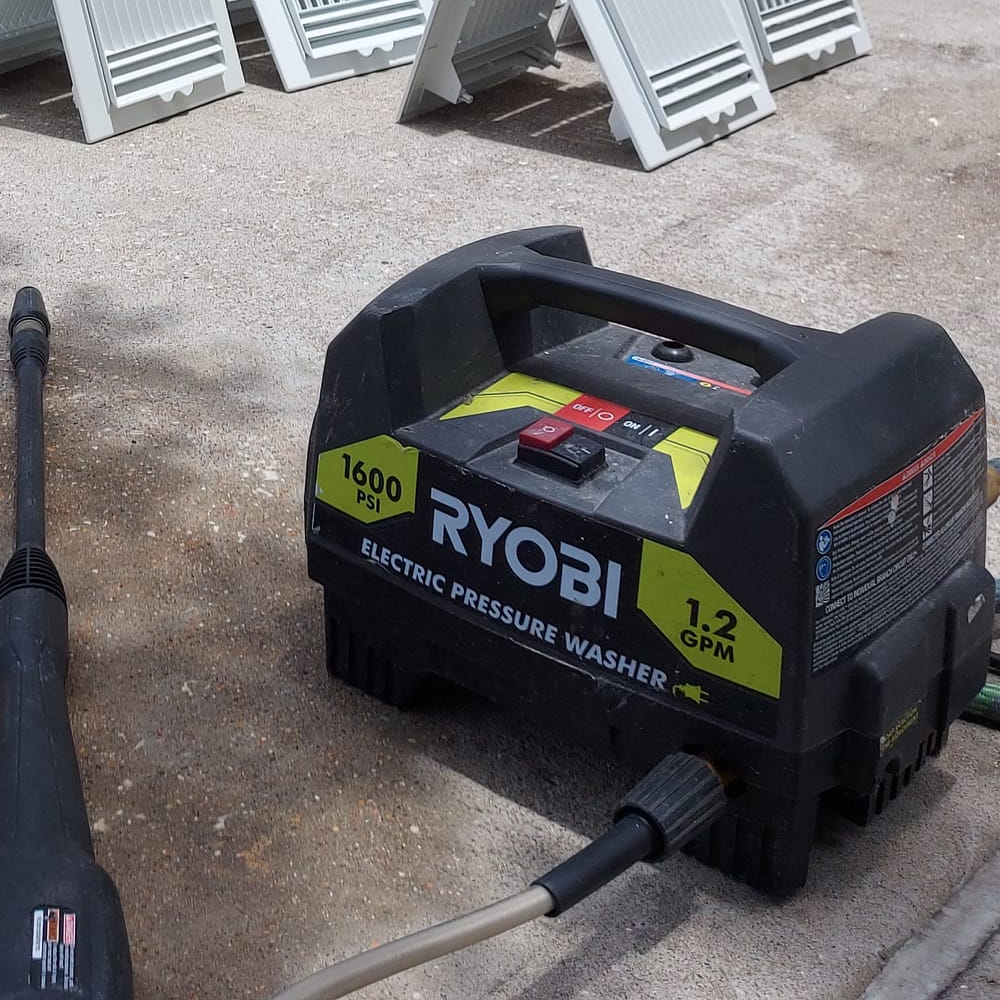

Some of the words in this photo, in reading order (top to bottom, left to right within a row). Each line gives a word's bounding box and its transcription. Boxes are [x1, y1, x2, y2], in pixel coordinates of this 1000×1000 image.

[573, 404, 594, 413] OFF
[623, 421, 641, 430] ON
[341, 454, 402, 502] 1600
[356, 491, 381, 514] PSI
[430, 487, 621, 619] RYOBI
[361, 537, 446, 593] ELECTRIC
[451, 581, 558, 644] PRESSURE
[565, 630, 668, 690] WASHER
[686, 597, 738, 642] 1.2
[680, 629, 735, 664] GPM
